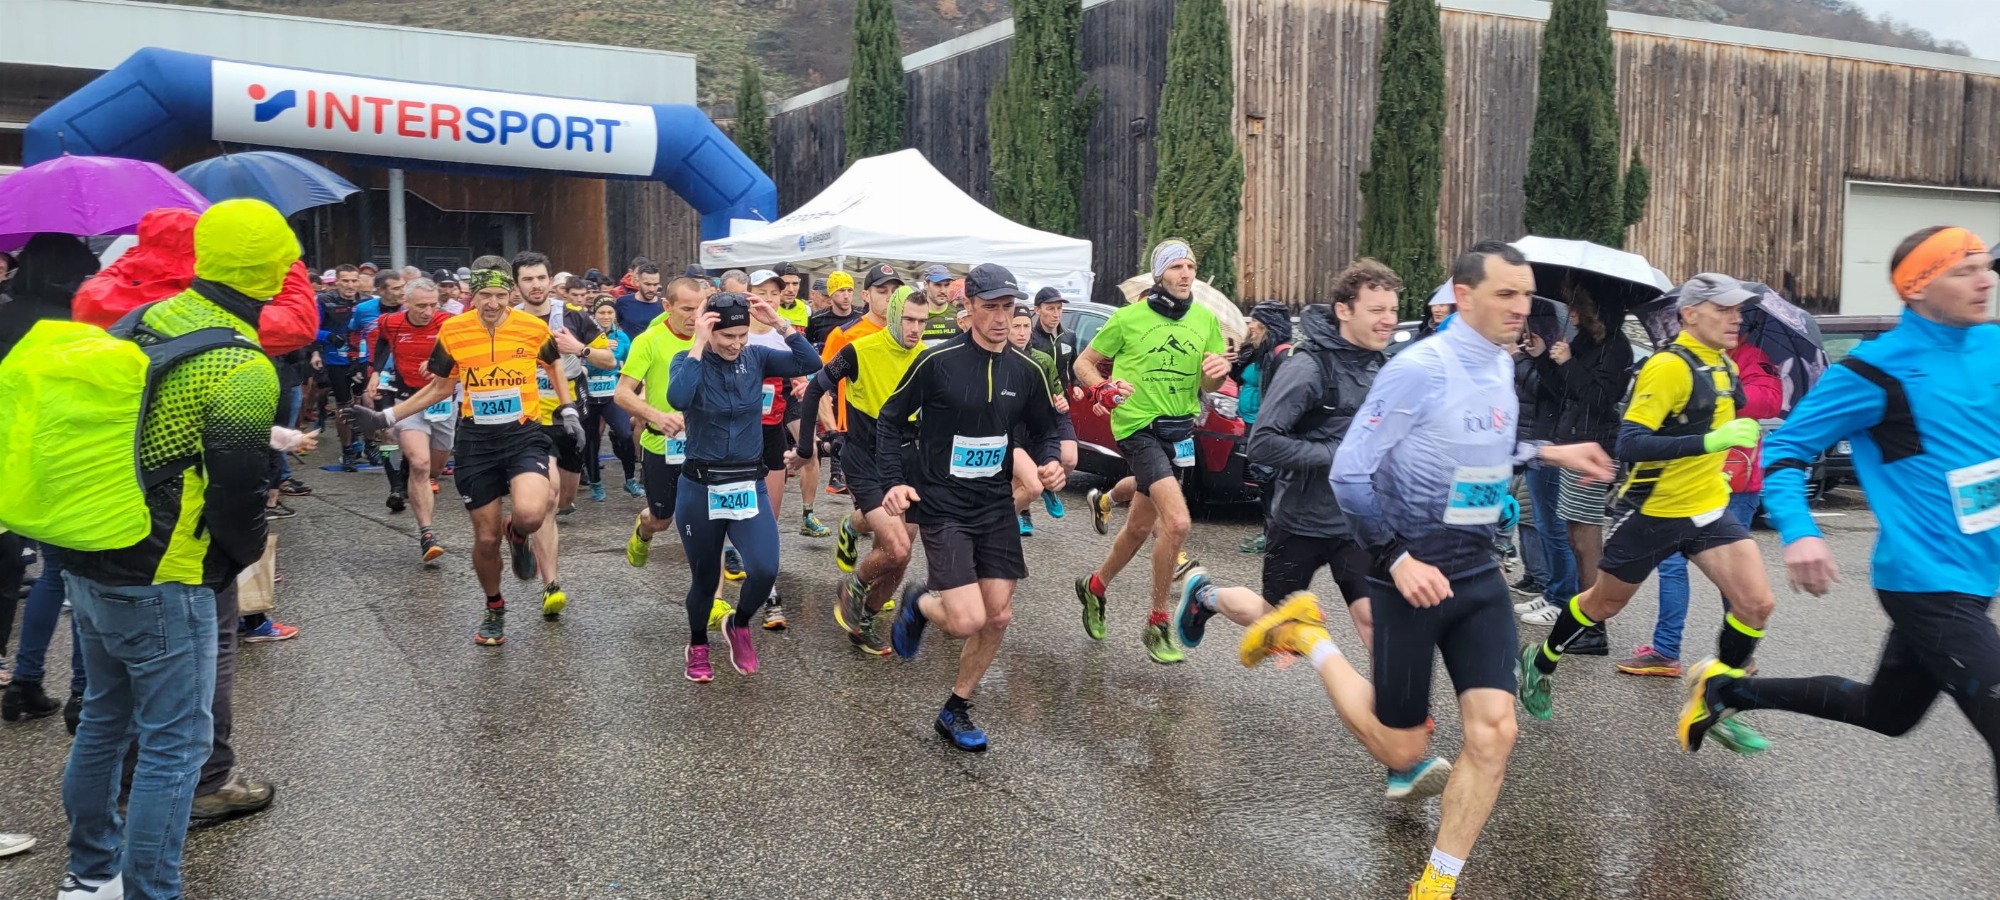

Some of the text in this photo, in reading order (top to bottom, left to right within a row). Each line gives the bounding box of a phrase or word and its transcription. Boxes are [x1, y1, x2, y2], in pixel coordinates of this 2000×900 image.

[306, 89, 621, 153] INTERSPORT
[465, 367, 528, 391] ALTITUDE
[593, 382, 611, 391] 2372
[481, 400, 512, 415] 2347
[965, 449, 1001, 467] 2375
[720, 492, 749, 509] 2340
